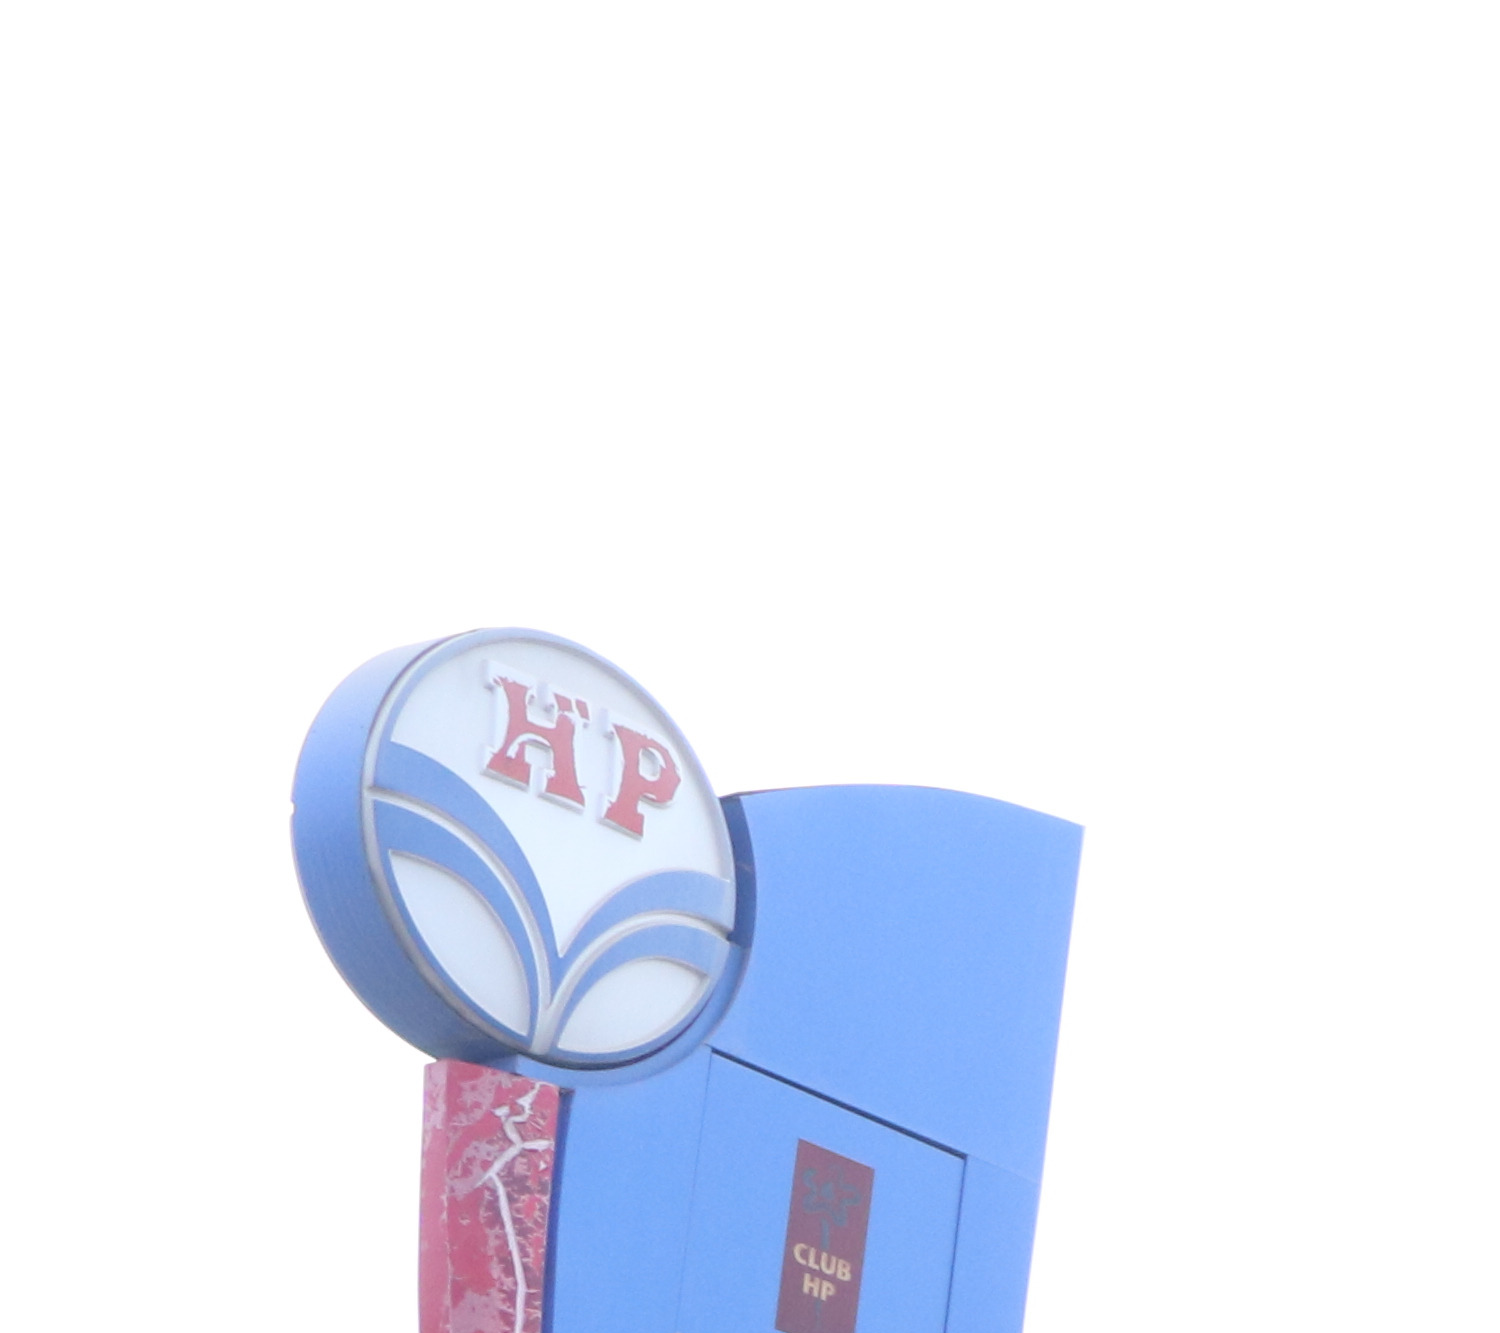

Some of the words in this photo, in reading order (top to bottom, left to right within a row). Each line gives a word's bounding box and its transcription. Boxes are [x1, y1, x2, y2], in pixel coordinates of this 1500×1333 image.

[481, 659, 682, 839] HP
[794, 1243, 852, 1283] CLUB
[802, 1274, 836, 1301] HP
